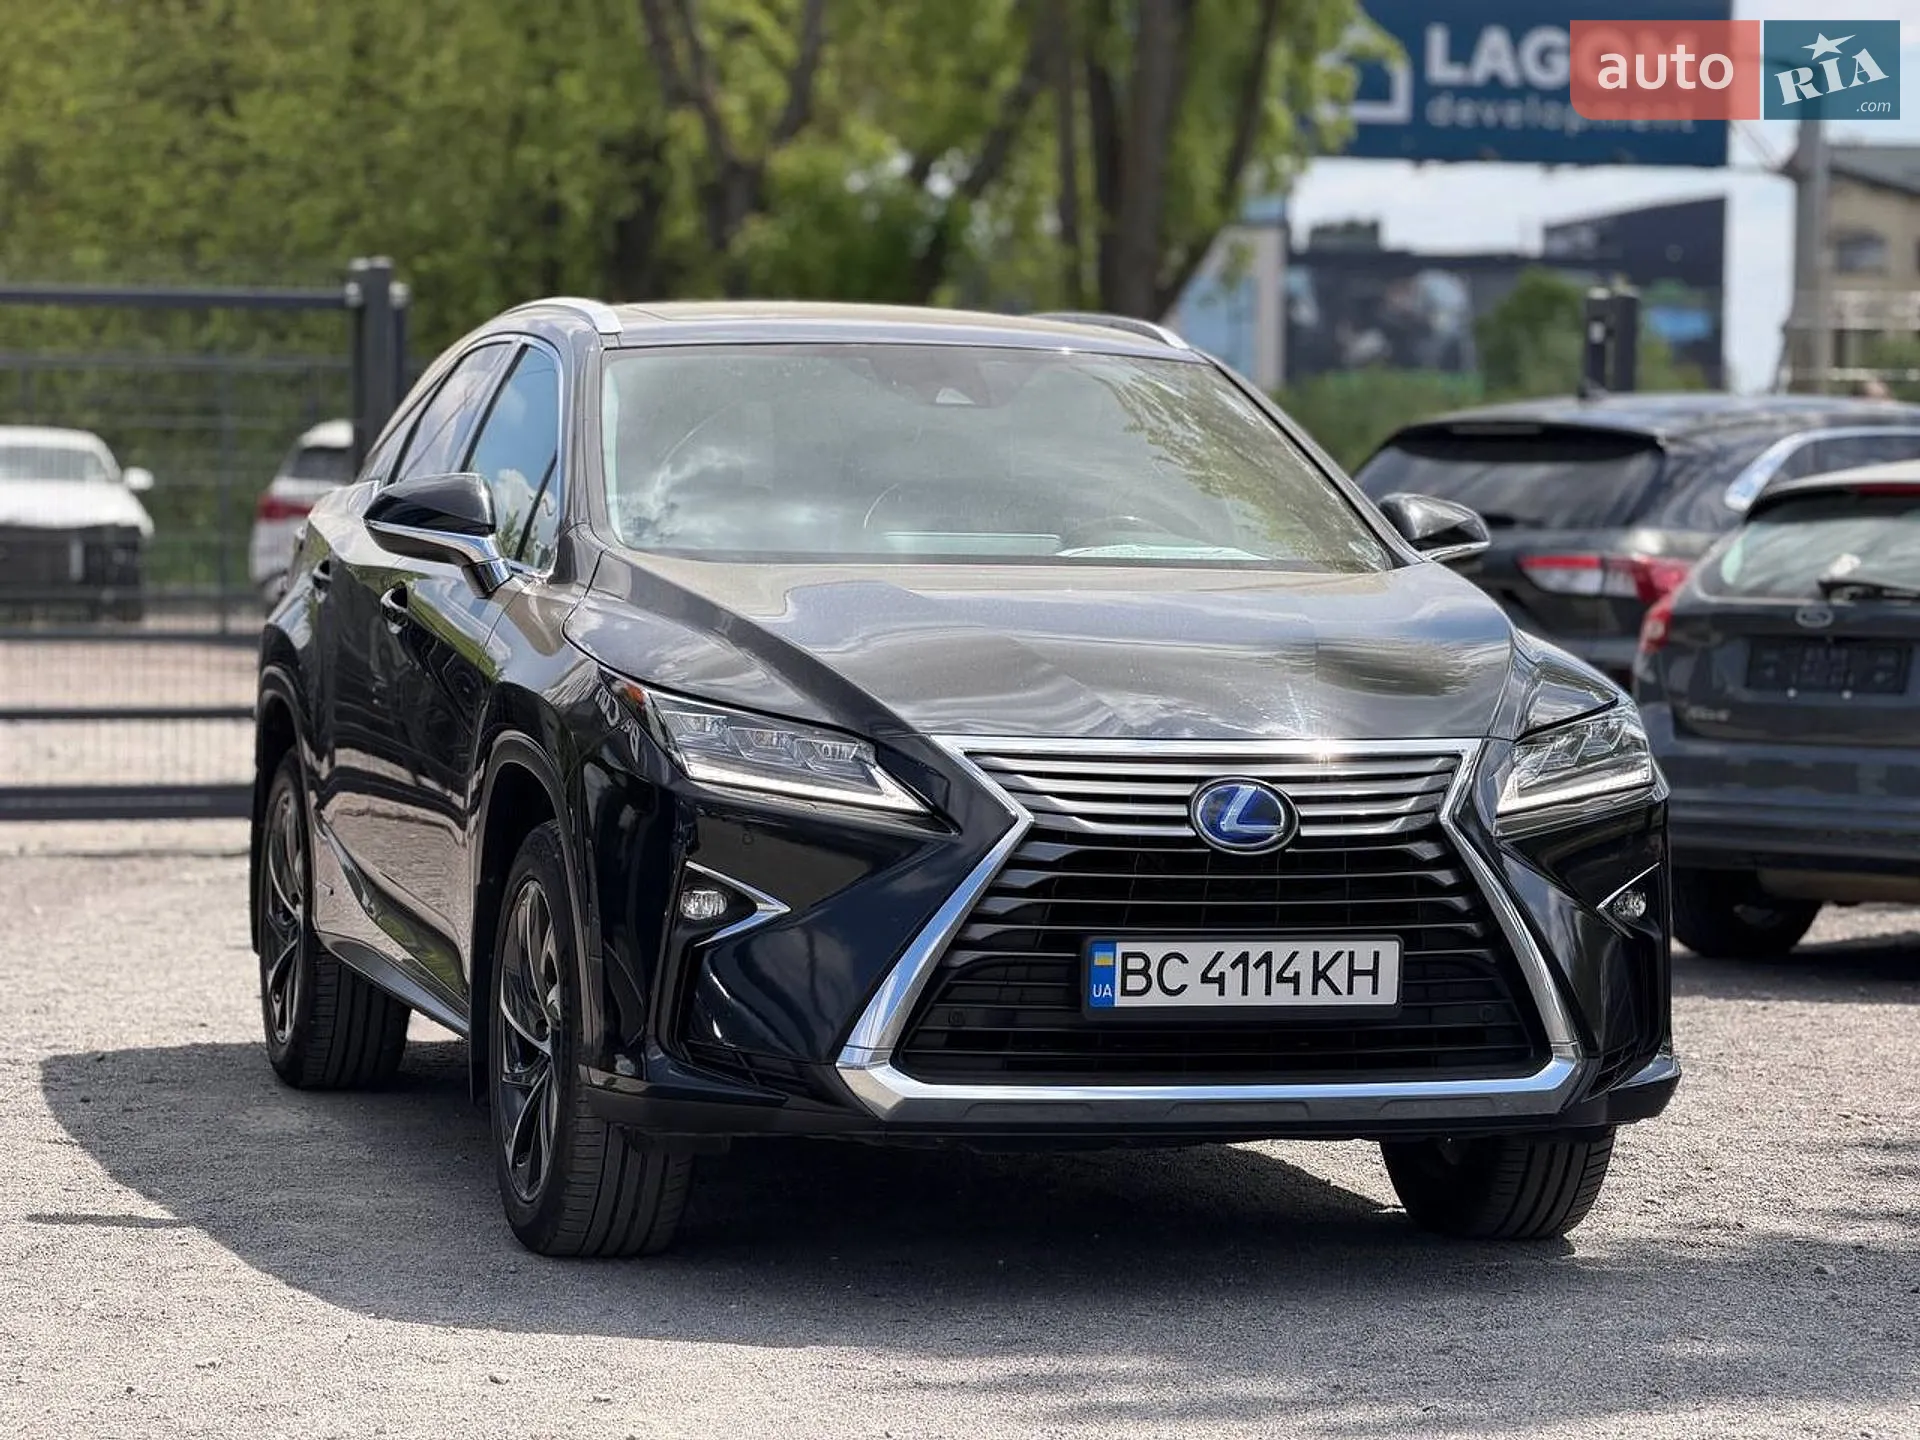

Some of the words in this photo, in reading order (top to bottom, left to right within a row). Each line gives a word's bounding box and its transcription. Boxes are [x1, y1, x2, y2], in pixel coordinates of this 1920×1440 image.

[1120, 951, 1189, 997] BC
[1200, 950, 1301, 997] 4114
[1311, 950, 1380, 996] KH
[1093, 983, 1113, 998] UA
